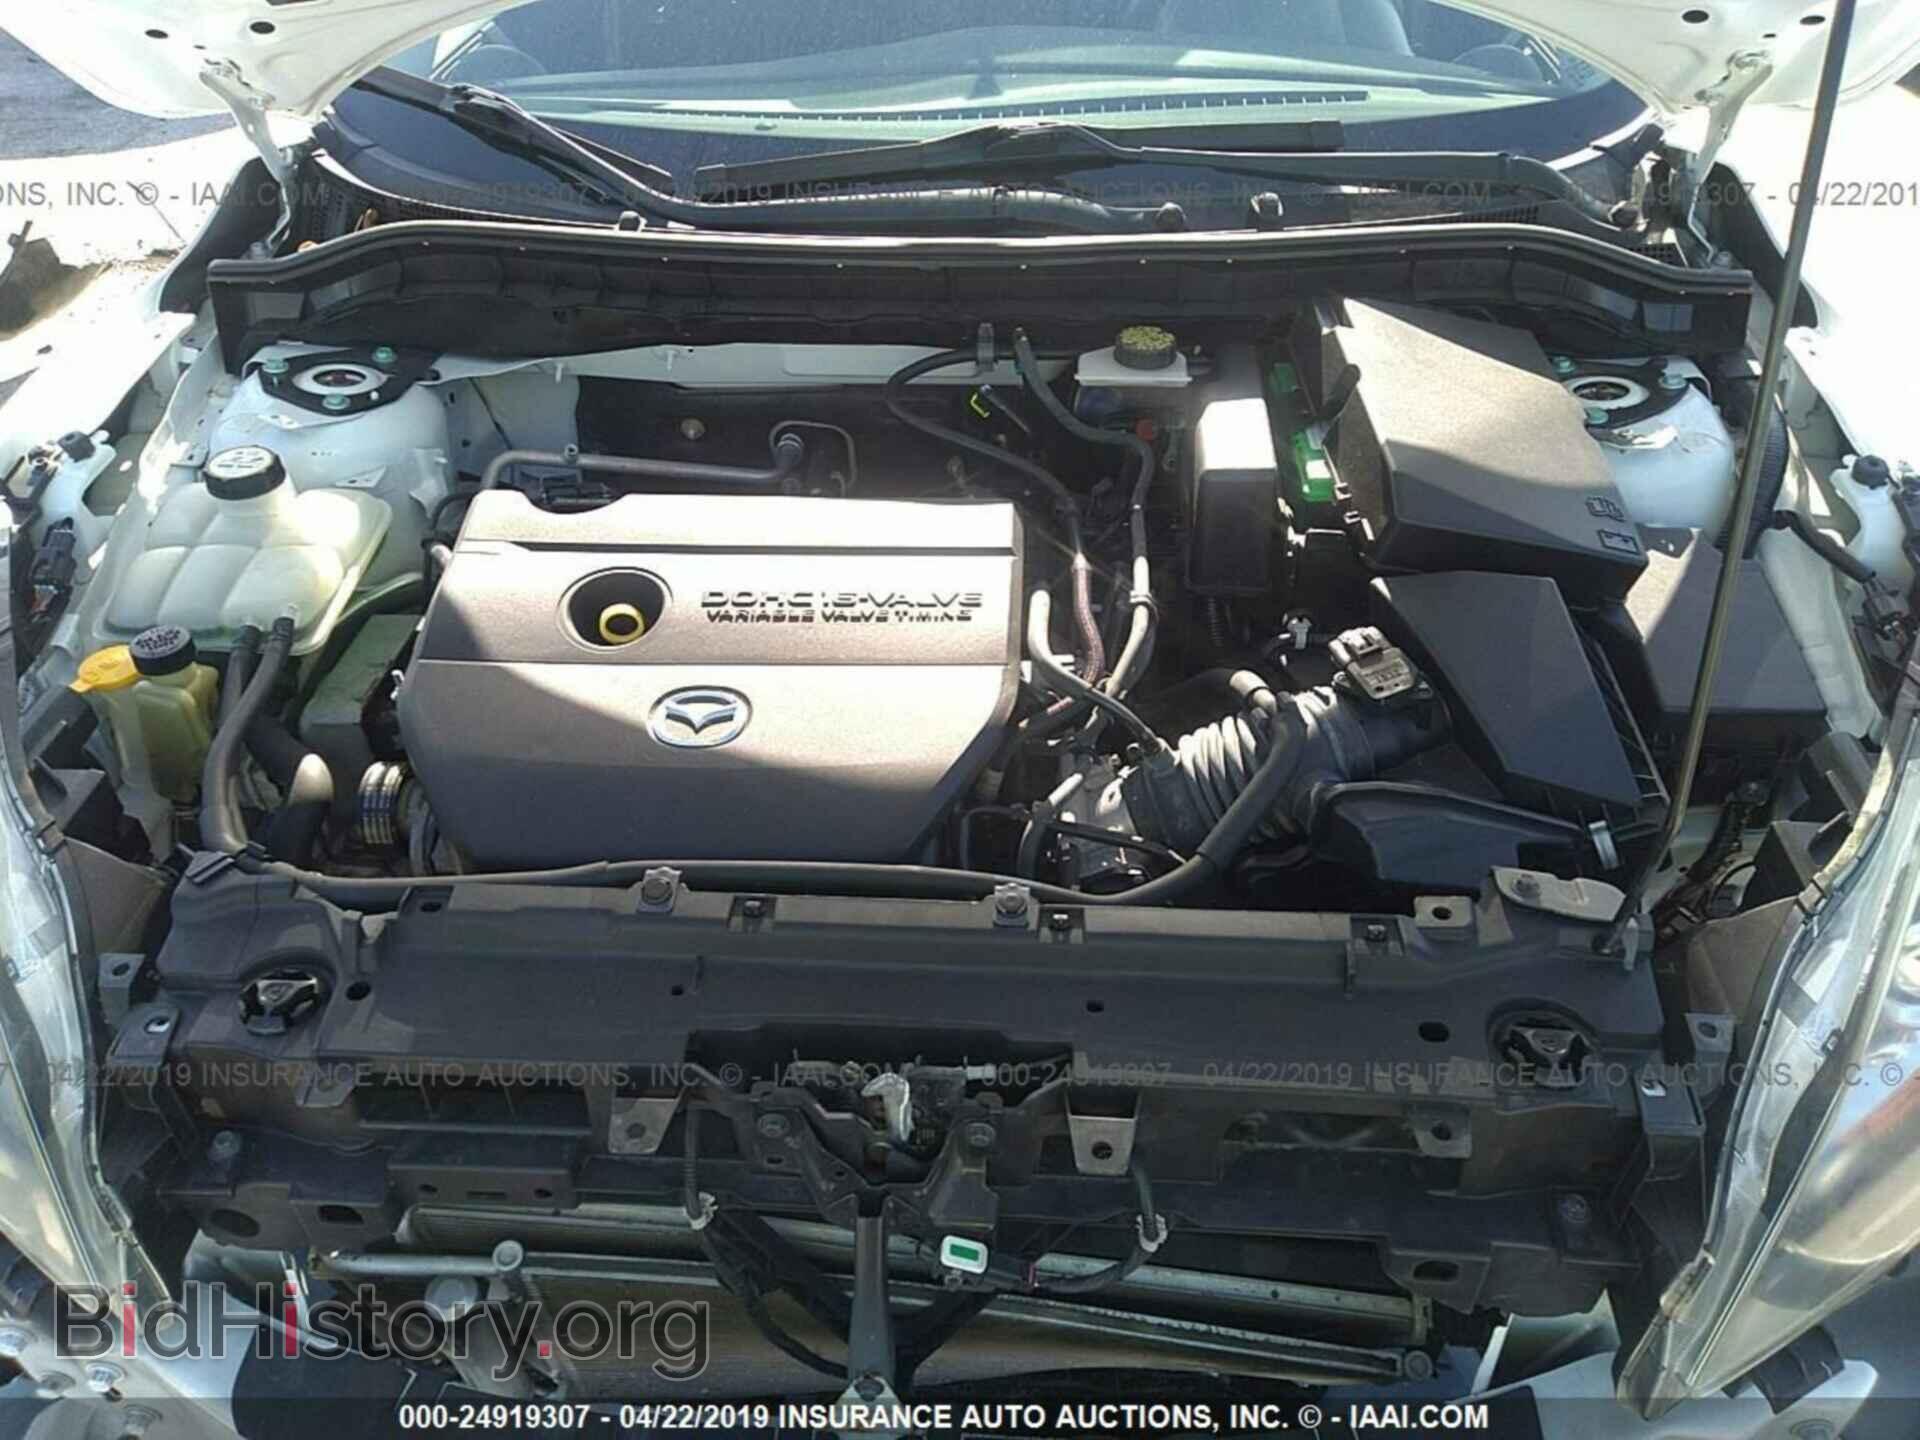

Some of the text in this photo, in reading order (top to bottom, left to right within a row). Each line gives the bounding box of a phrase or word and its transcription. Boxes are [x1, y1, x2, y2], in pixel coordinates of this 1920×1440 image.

[701, 591, 813, 607] DOHC
[706, 610, 815, 623] VARIABLE
[820, 610, 889, 623] VALVE
